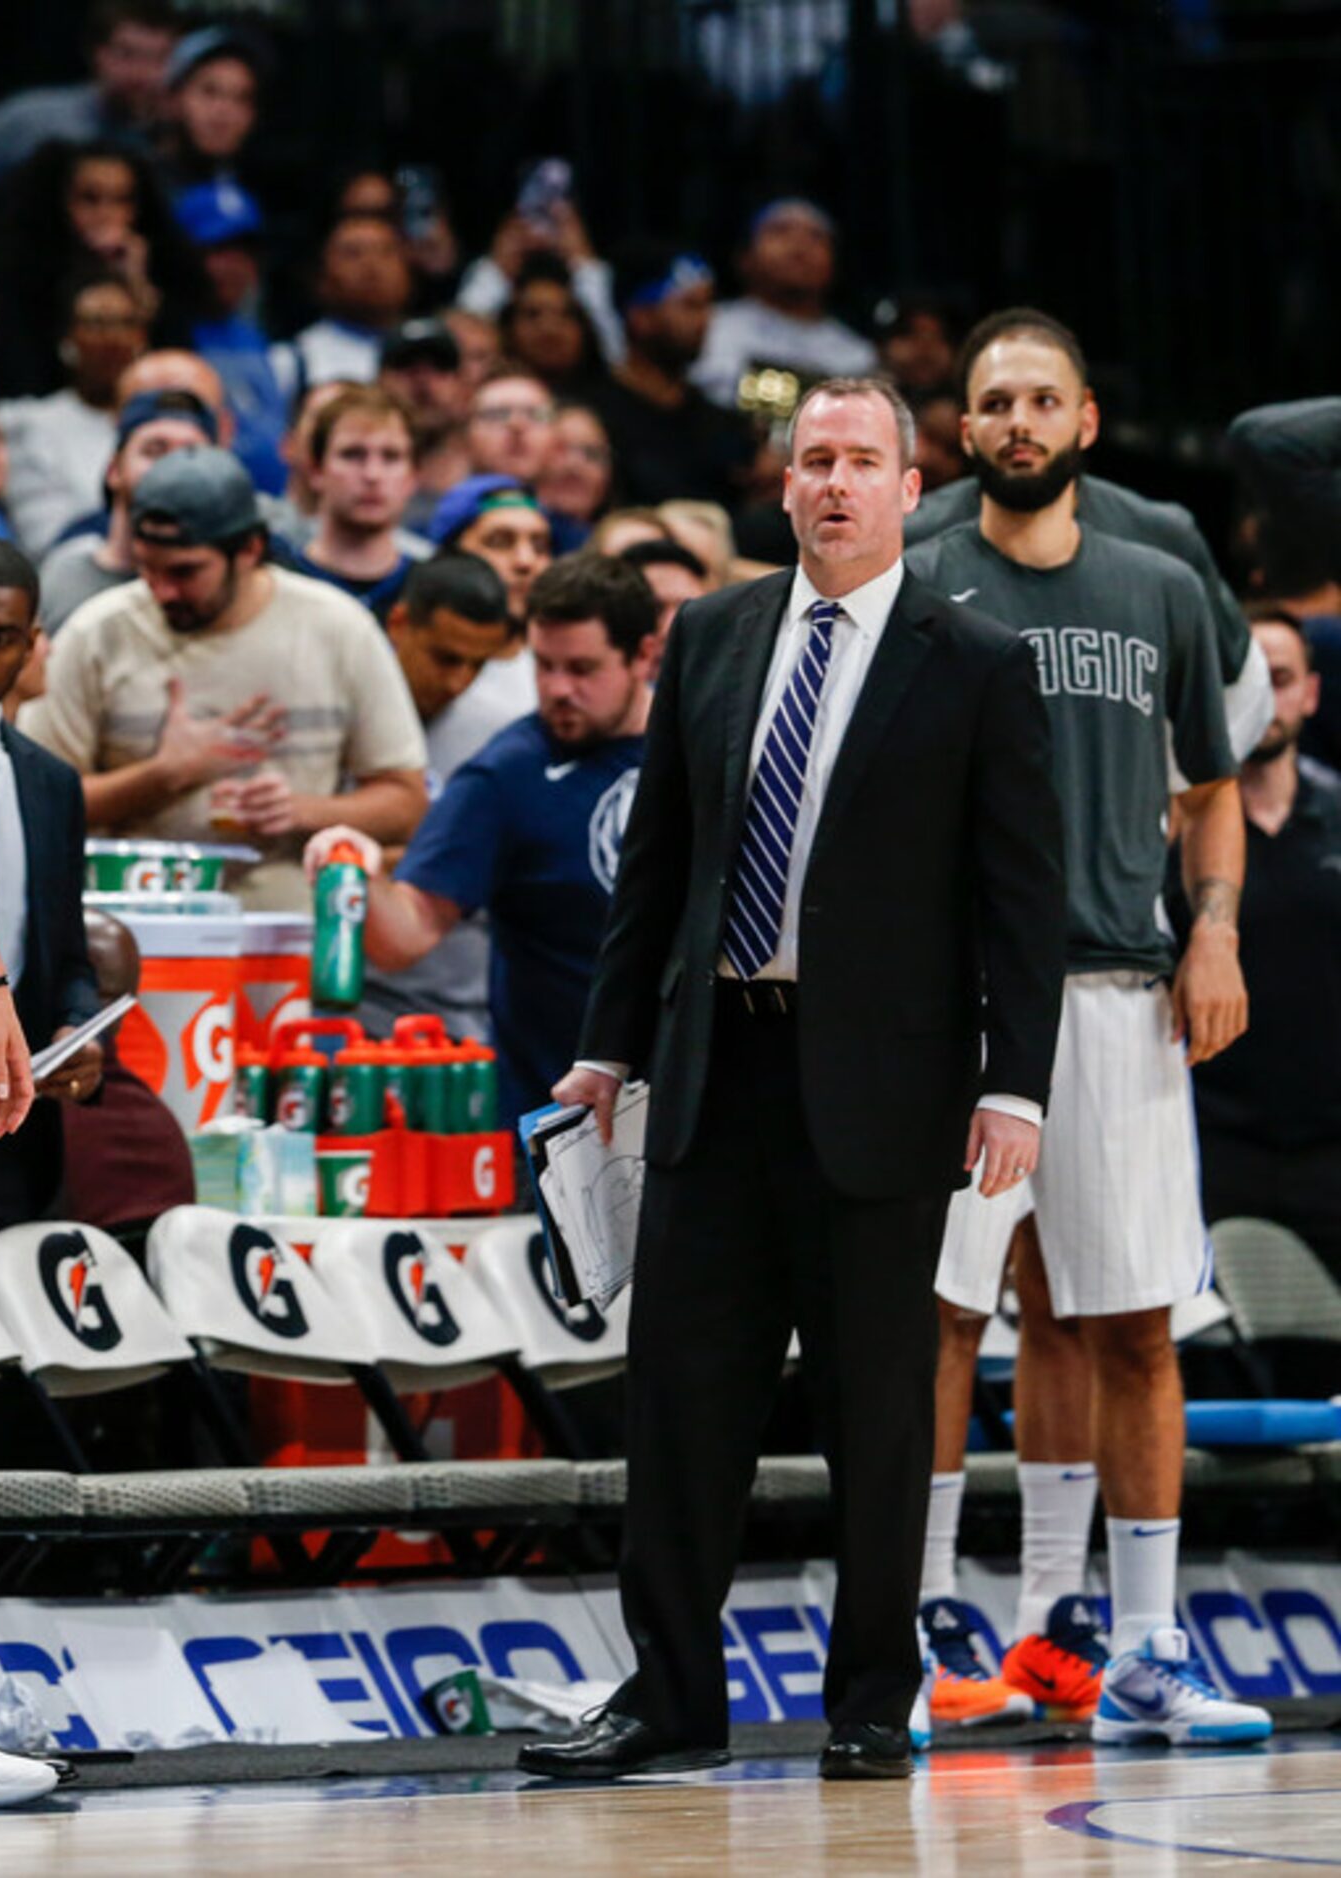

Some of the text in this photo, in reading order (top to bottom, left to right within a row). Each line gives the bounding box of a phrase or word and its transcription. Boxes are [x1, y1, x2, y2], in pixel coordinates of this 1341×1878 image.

[193, 1004, 233, 1082] G
[473, 1146, 496, 1199] G
[38, 1229, 123, 1352] G
[228, 1222, 309, 1338] G
[383, 1230, 461, 1347] G
